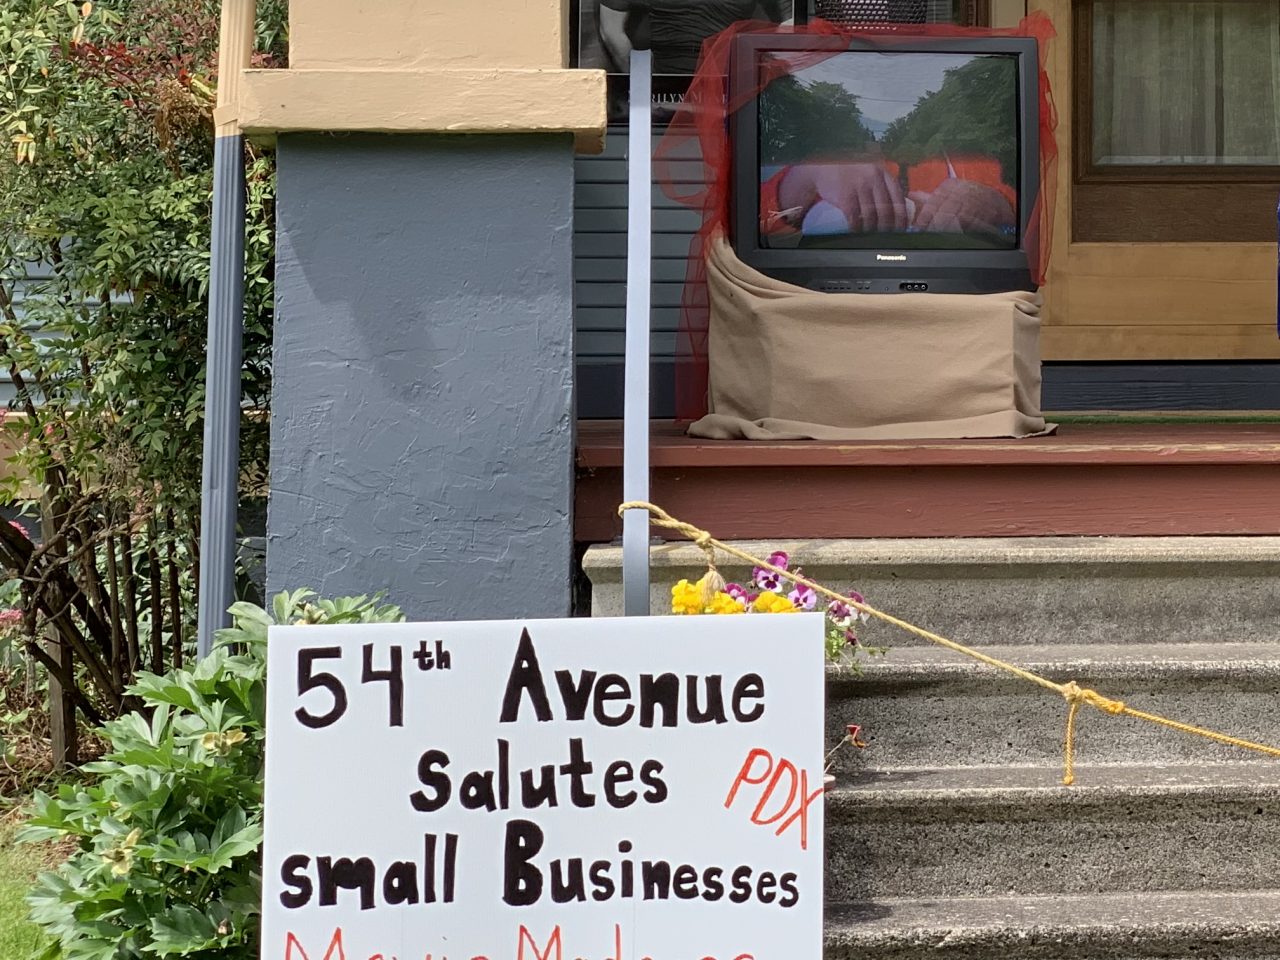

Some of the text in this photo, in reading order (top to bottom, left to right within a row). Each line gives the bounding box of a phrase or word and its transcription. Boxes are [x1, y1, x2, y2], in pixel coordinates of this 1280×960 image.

[294, 626, 766, 729] 54th Avenue
[724, 747, 824, 850] PDX
[279, 819, 801, 910] small Businesses
